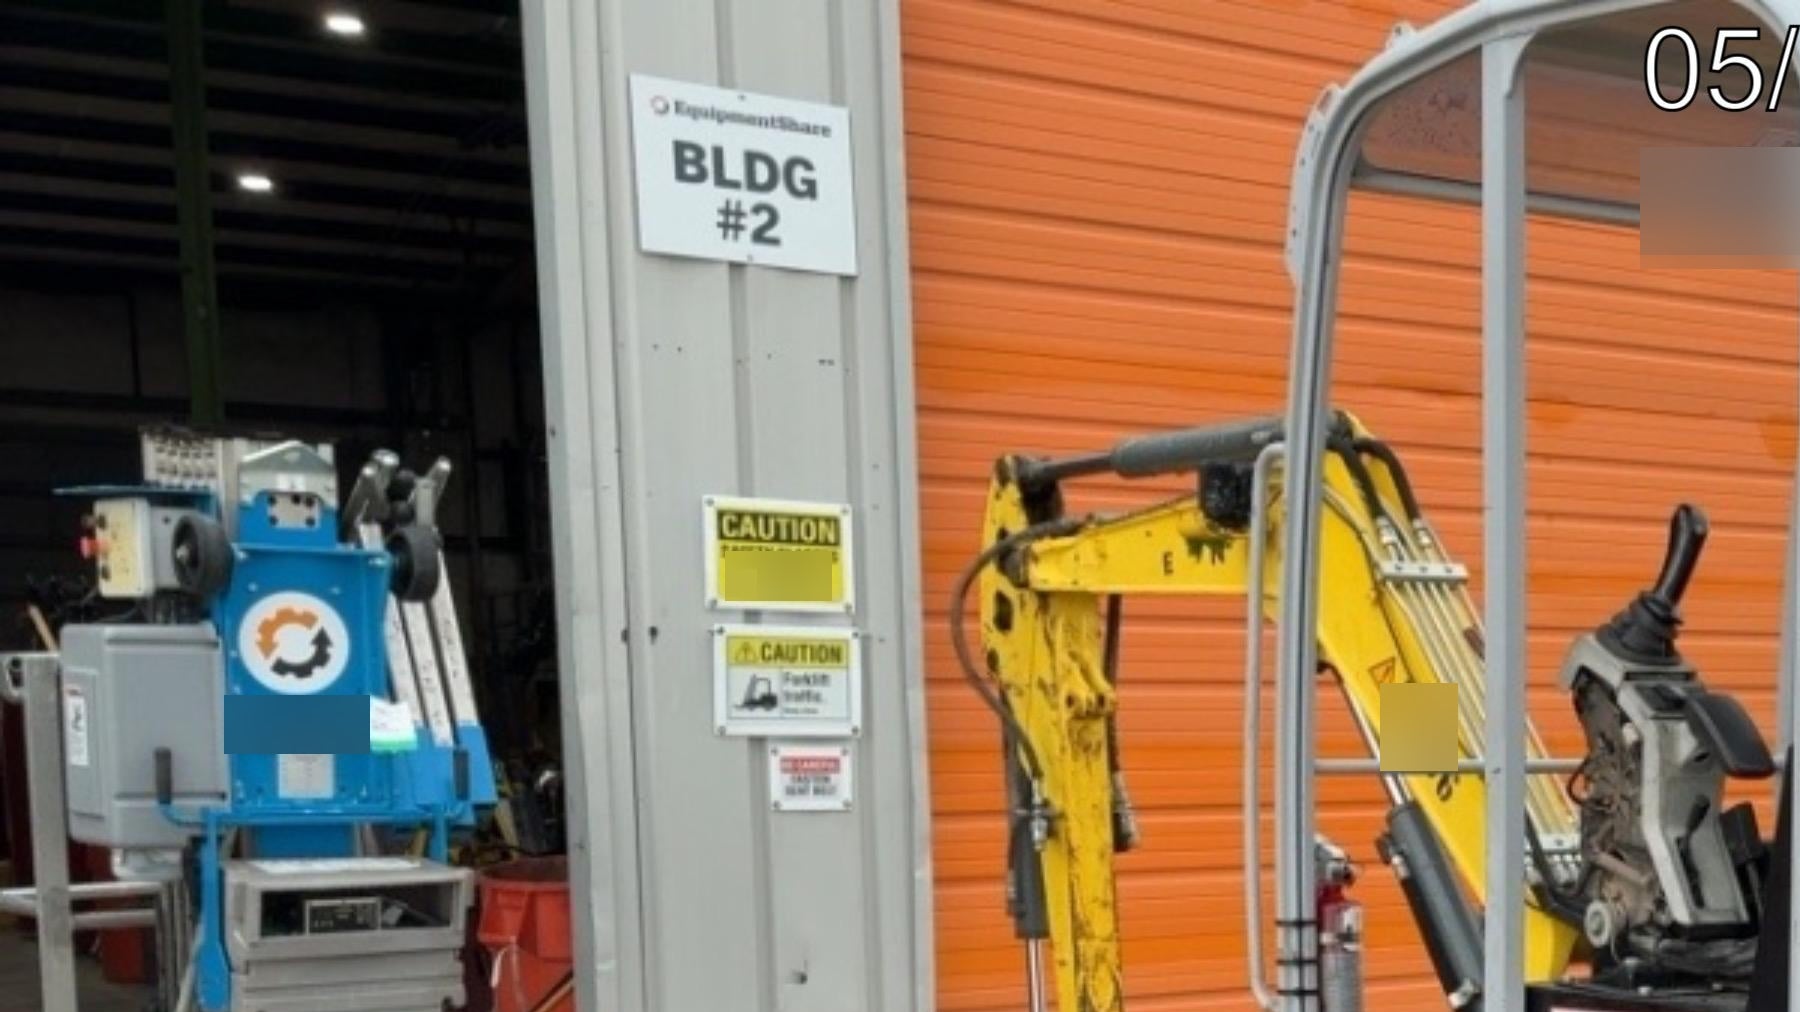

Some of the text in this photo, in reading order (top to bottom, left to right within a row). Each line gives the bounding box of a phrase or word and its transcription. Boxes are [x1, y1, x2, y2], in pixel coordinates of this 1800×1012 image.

[674, 100, 832, 138] EquipmentShare
[672, 140, 818, 201] BLDG
[716, 198, 782, 247] #2
[721, 513, 836, 544] CAUTION
[760, 641, 842, 665] CAUTION
